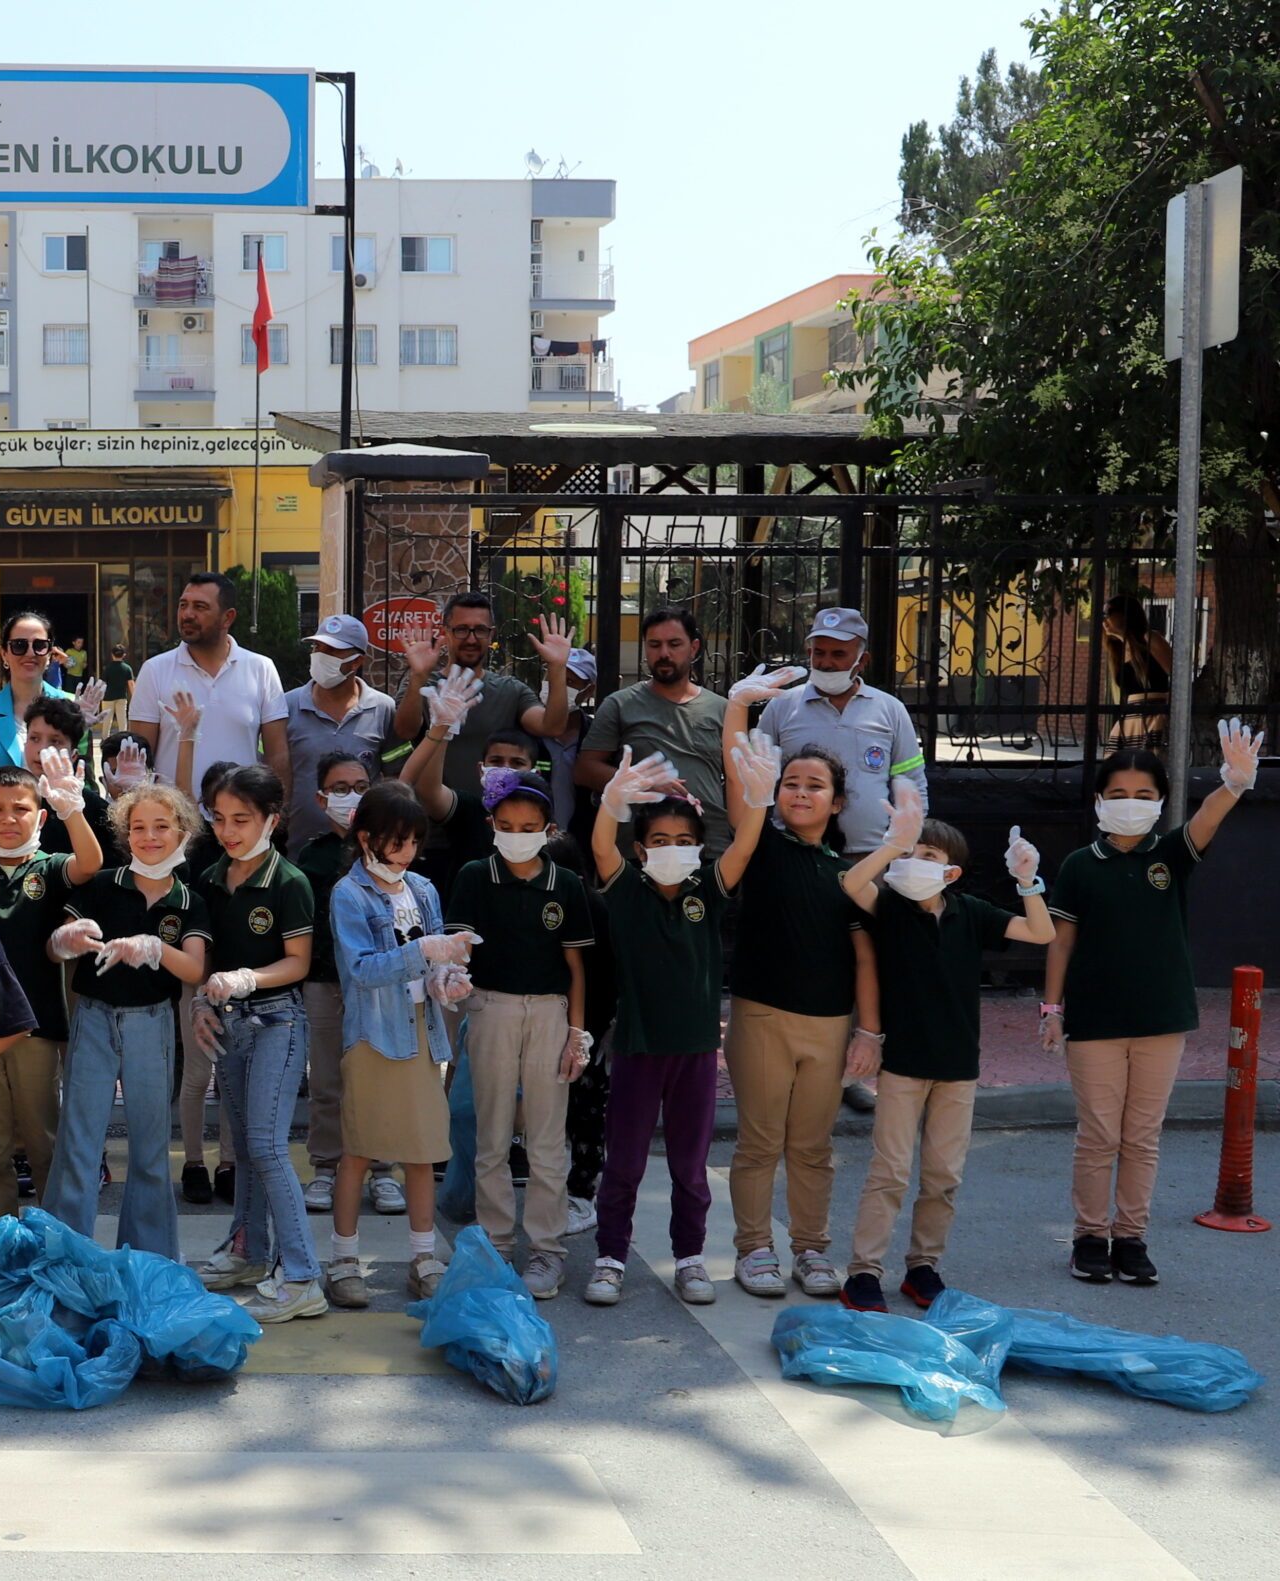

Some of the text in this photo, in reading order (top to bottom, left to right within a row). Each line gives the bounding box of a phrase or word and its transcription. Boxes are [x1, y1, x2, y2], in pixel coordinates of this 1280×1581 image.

[52, 136, 243, 175] İLKOKULU
[33, 436, 91, 455] beyler;
[97, 436, 134, 450] sizin
[6, 503, 82, 526] GÜVEN
[92, 502, 203, 525] İLKOKULU
